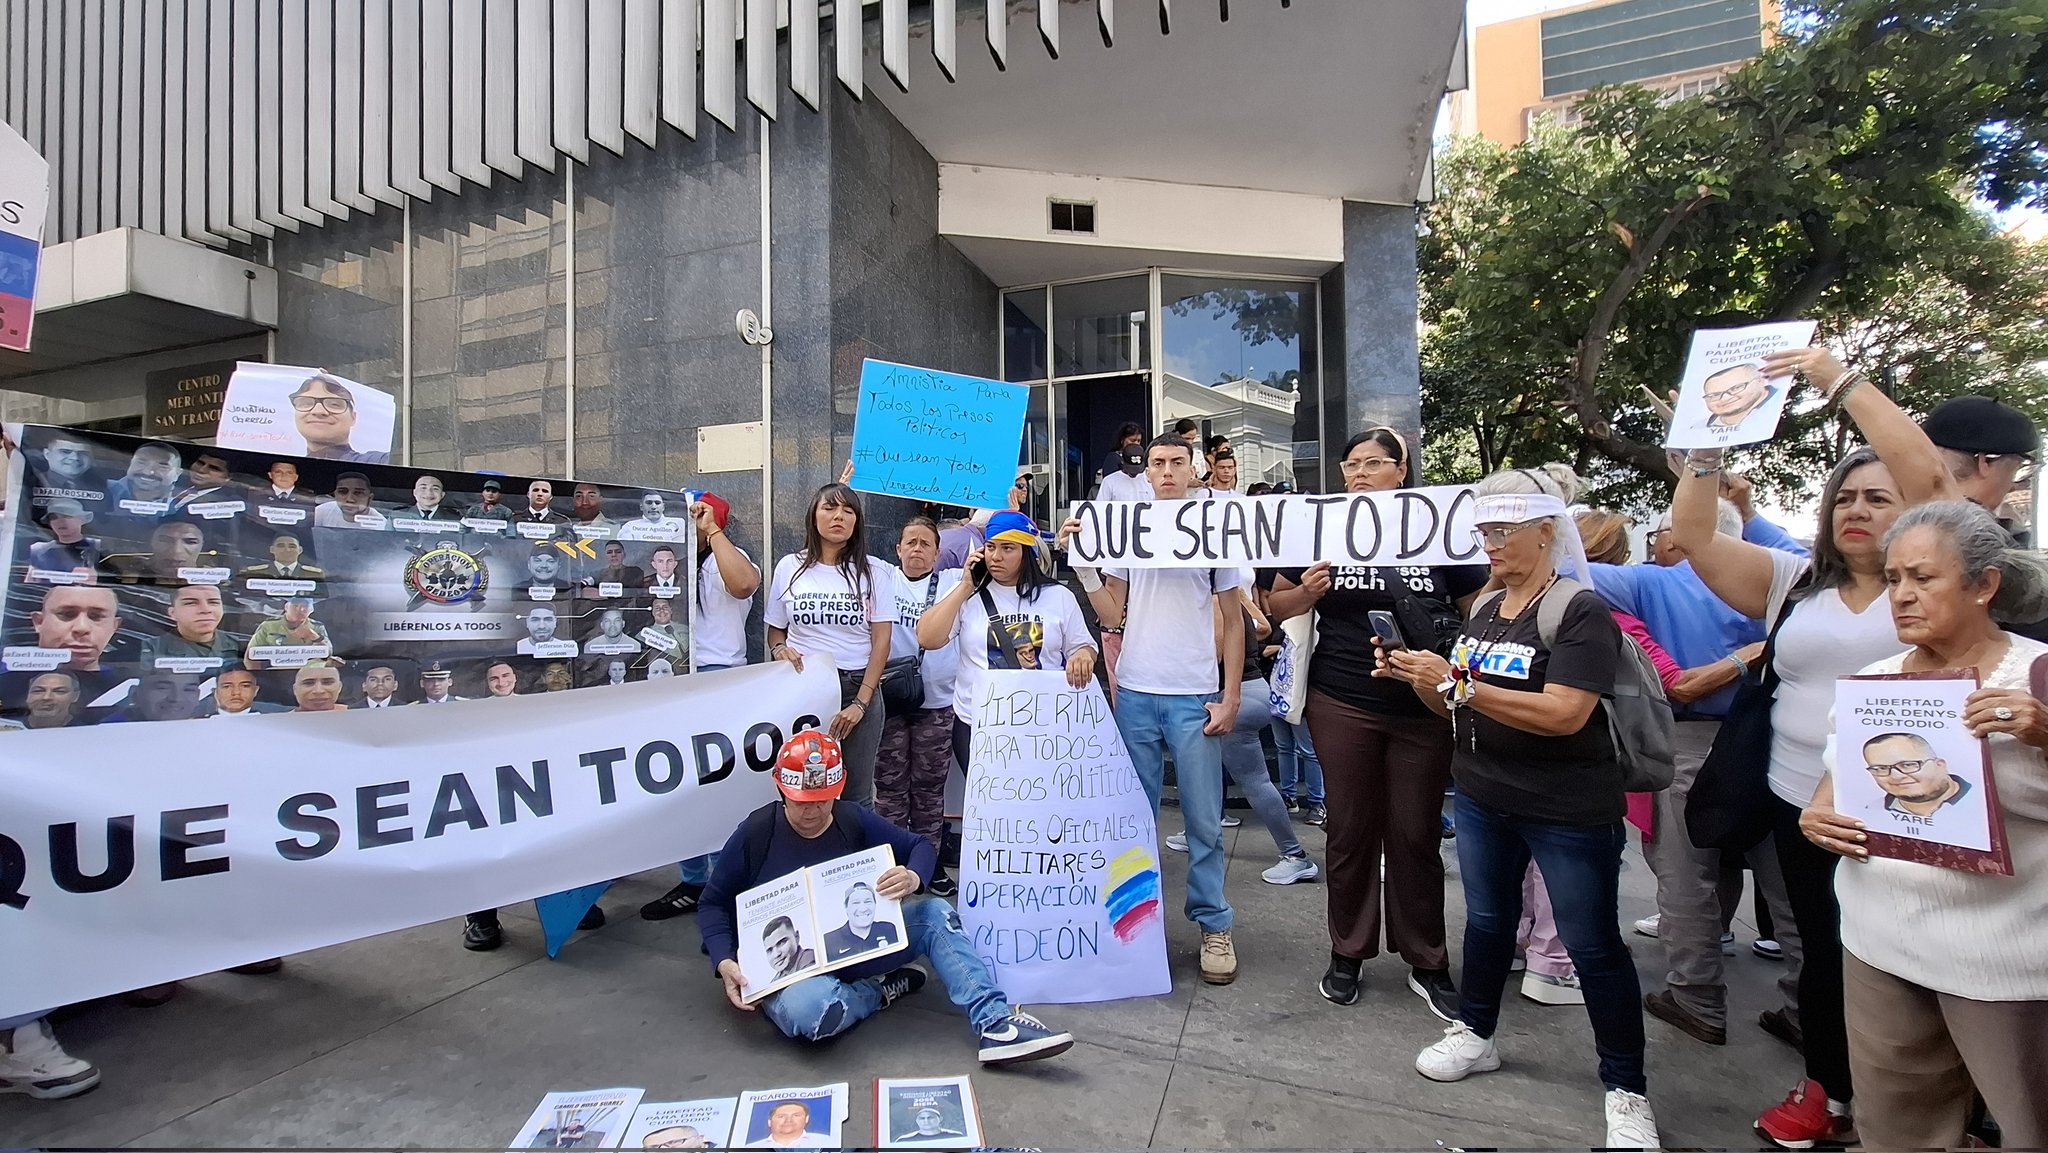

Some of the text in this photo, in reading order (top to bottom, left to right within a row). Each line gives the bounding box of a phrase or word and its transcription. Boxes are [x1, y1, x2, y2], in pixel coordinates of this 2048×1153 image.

[1705, 340, 1789, 357] PARA DENYS
[1717, 334, 1783, 349] LIBERTAD
[177, 374, 221, 392] CENTRO
[869, 390, 913, 414] Todos
[945, 403, 994, 423] Presos
[155, 415, 176, 427] SAN
[1710, 425, 1741, 435] YARE
[1073, 501, 1154, 563] QUE
[1173, 499, 1287, 561] SEAN
[422, 554, 472, 570] OPERACION
[425, 584, 468, 598] GEDEON
[793, 601, 864, 612] LOS PRESOS
[384, 621, 502, 631] LIBÉRENLOS A TODOS
[793, 611, 864, 626] POLÍTICOS
[978, 682, 1106, 733] LIBERTAD
[1866, 698, 1944, 707] LIBERTAD
[1855, 708, 1957, 718] PARA DENYS
[973, 731, 1021, 769] PARA
[1025, 733, 1103, 761] TODOS
[970, 762, 1142, 801] PRESOS POLÍTICOS
[275, 760, 554, 862] SEAN
[1890, 812, 1934, 826] YARE
[1046, 813, 1139, 844] OFICIALES
[1907, 827, 1919, 835] III
[821, 857, 875, 878] LIBERTAD PARA
[976, 849, 1106, 884] MILITARES
[744, 881, 800, 909] LIBERTAD PARA
[966, 876, 1097, 913] OPERACIÓN
[750, 1089, 836, 1101] RICARDO CARIEL
[656, 1107, 713, 1115] LIBERTAD
